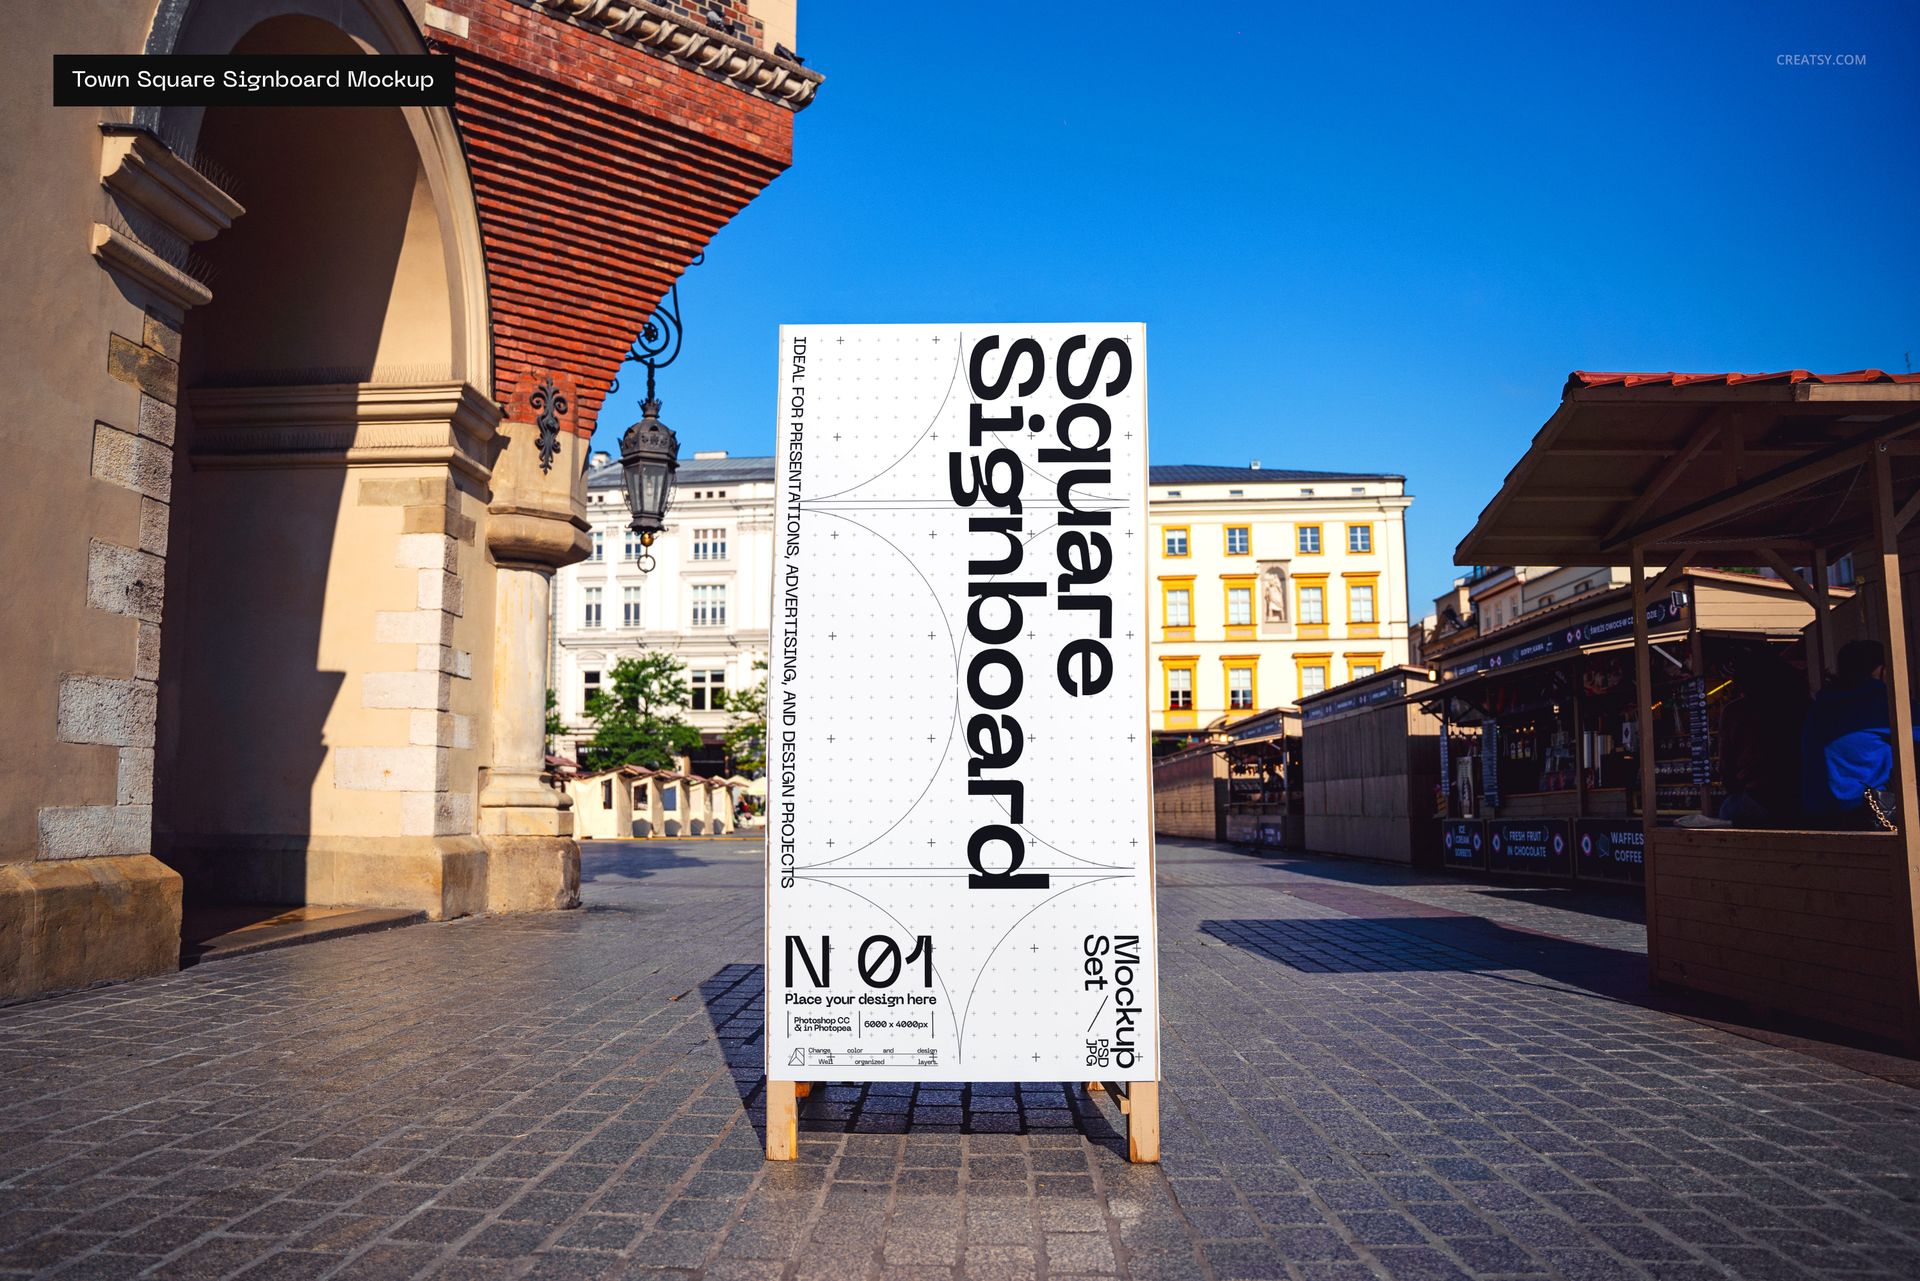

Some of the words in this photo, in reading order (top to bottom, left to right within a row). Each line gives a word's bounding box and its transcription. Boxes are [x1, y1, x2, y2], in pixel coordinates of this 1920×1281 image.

[792, 336, 807, 383] IDEAL
[791, 387, 805, 418] FOR
[783, 422, 804, 559] PRESENTATIONS,
[1037, 334, 1132, 698] Square
[781, 564, 799, 686] ADVERTISING,
[948, 334, 1050, 890] Signboard
[782, 690, 796, 726] AND
[781, 731, 796, 797] DESIGN
[780, 802, 796, 889] PROJECTS
[1509, 831, 1526, 841] FRESH
[1526, 831, 1542, 841] FRUIT
[1514, 846, 1547, 858] CHOCOLATE
[1610, 832, 1645, 845] WAFFLES
[1614, 850, 1643, 863] COFFEE
[785, 935, 830, 988] N
[857, 934, 933, 989] 01
[1083, 934, 1110, 991] Set
[785, 993, 822, 1005] Place
[826, 996, 856, 1008] your
[858, 993, 904, 1007] design
[907, 993, 937, 1005] here
[1109, 935, 1143, 1069] Mockup
[794, 1016, 836, 1025] Photoshop
[837, 1016, 850, 1025] CC
[794, 1024, 802, 1032] &
[803, 1024, 812, 1032] in
[813, 1024, 852, 1033] Photopea
[864, 1020, 887, 1029] 6000
[895, 1020, 928, 1030] 4000px
[1085, 1038, 1098, 1067] JPG
[1097, 1038, 1110, 1068] PSD
